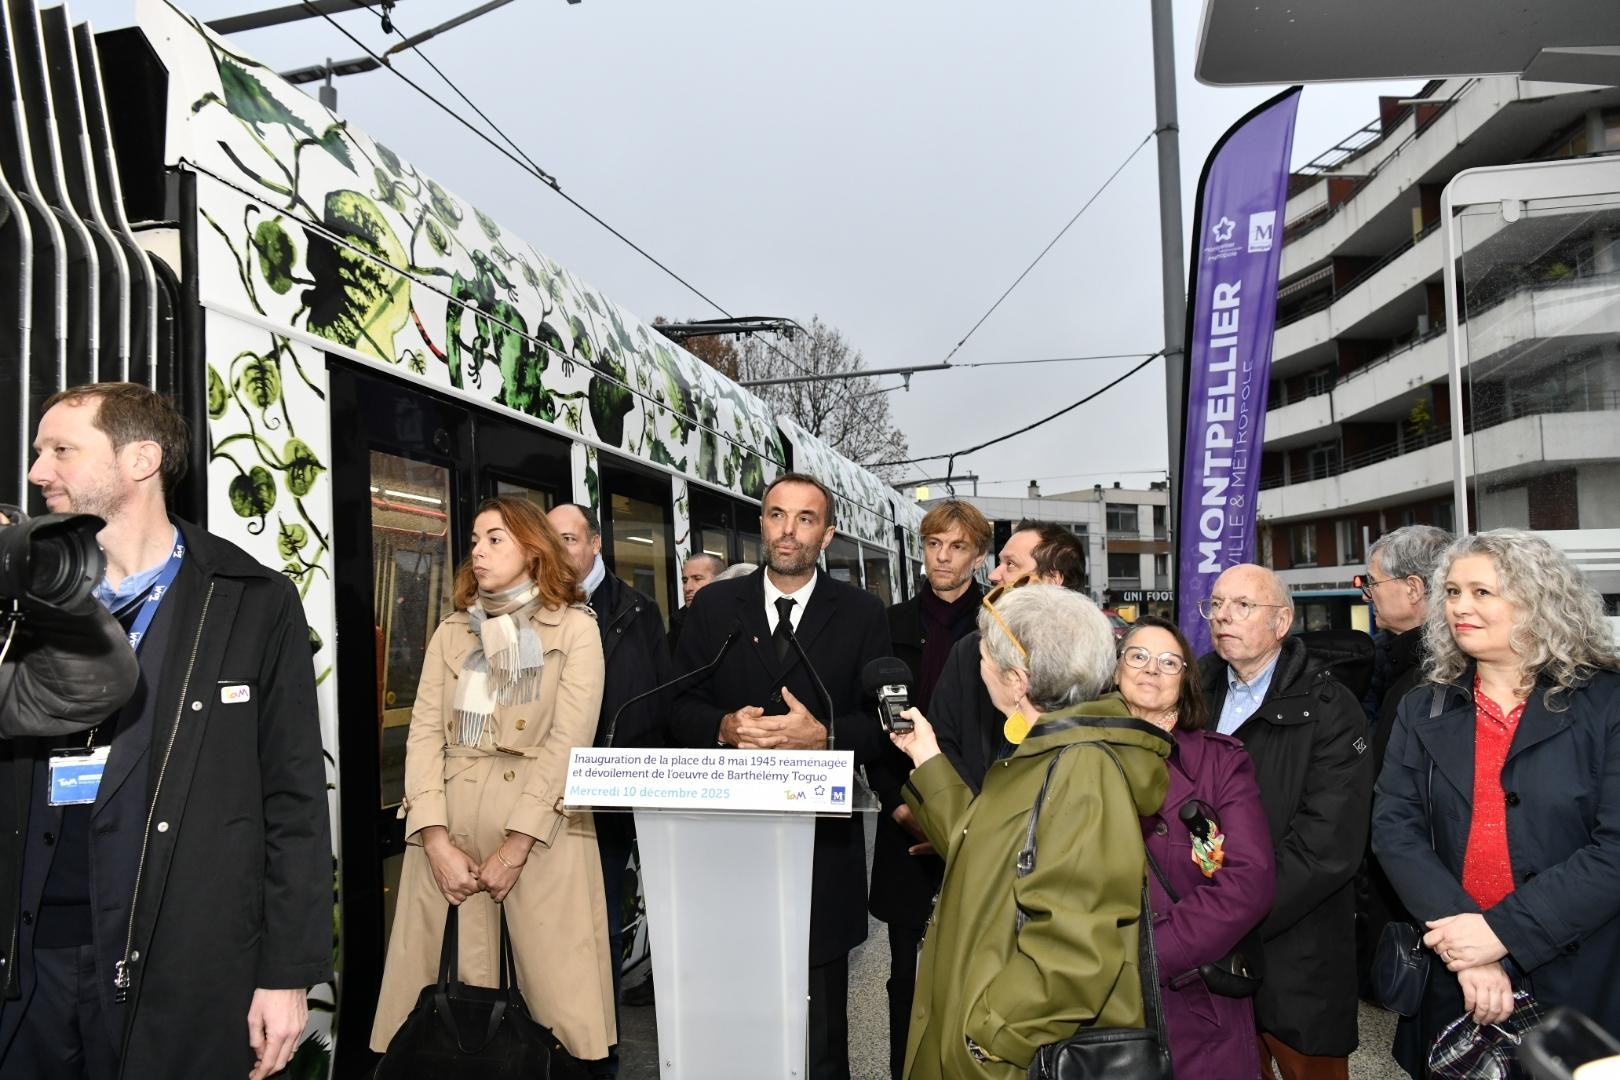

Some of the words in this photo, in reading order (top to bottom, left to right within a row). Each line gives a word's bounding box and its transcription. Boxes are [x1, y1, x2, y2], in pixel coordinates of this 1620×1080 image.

[1198, 280, 1241, 573] MONTPELLIER
[1229, 494, 1245, 508] &
[1123, 591, 1142, 601] UNI
[574, 754, 641, 766] Inauguration
[643, 755, 657, 765] de
[659, 755, 669, 765] la
[671, 755, 699, 767] place
[701, 756, 716, 766] du
[718, 756, 725, 766] 8
[727, 757, 748, 766] mai
[751, 757, 776, 766] 1945
[779, 758, 847, 769] réaménagée
[572, 768, 583, 777] et
[584, 768, 649, 778] dévoilement
[651, 769, 665, 779] de
[667, 769, 709, 779] l'oeuvre
[711, 770, 725, 780] de
[727, 770, 789, 783] Barthélémy
[791, 771, 828, 783] Toguo
[569, 785, 620, 797] Mercredi
[623, 786, 637, 797] 10
[639, 787, 698, 798] décembre
[701, 788, 730, 799] 2025
